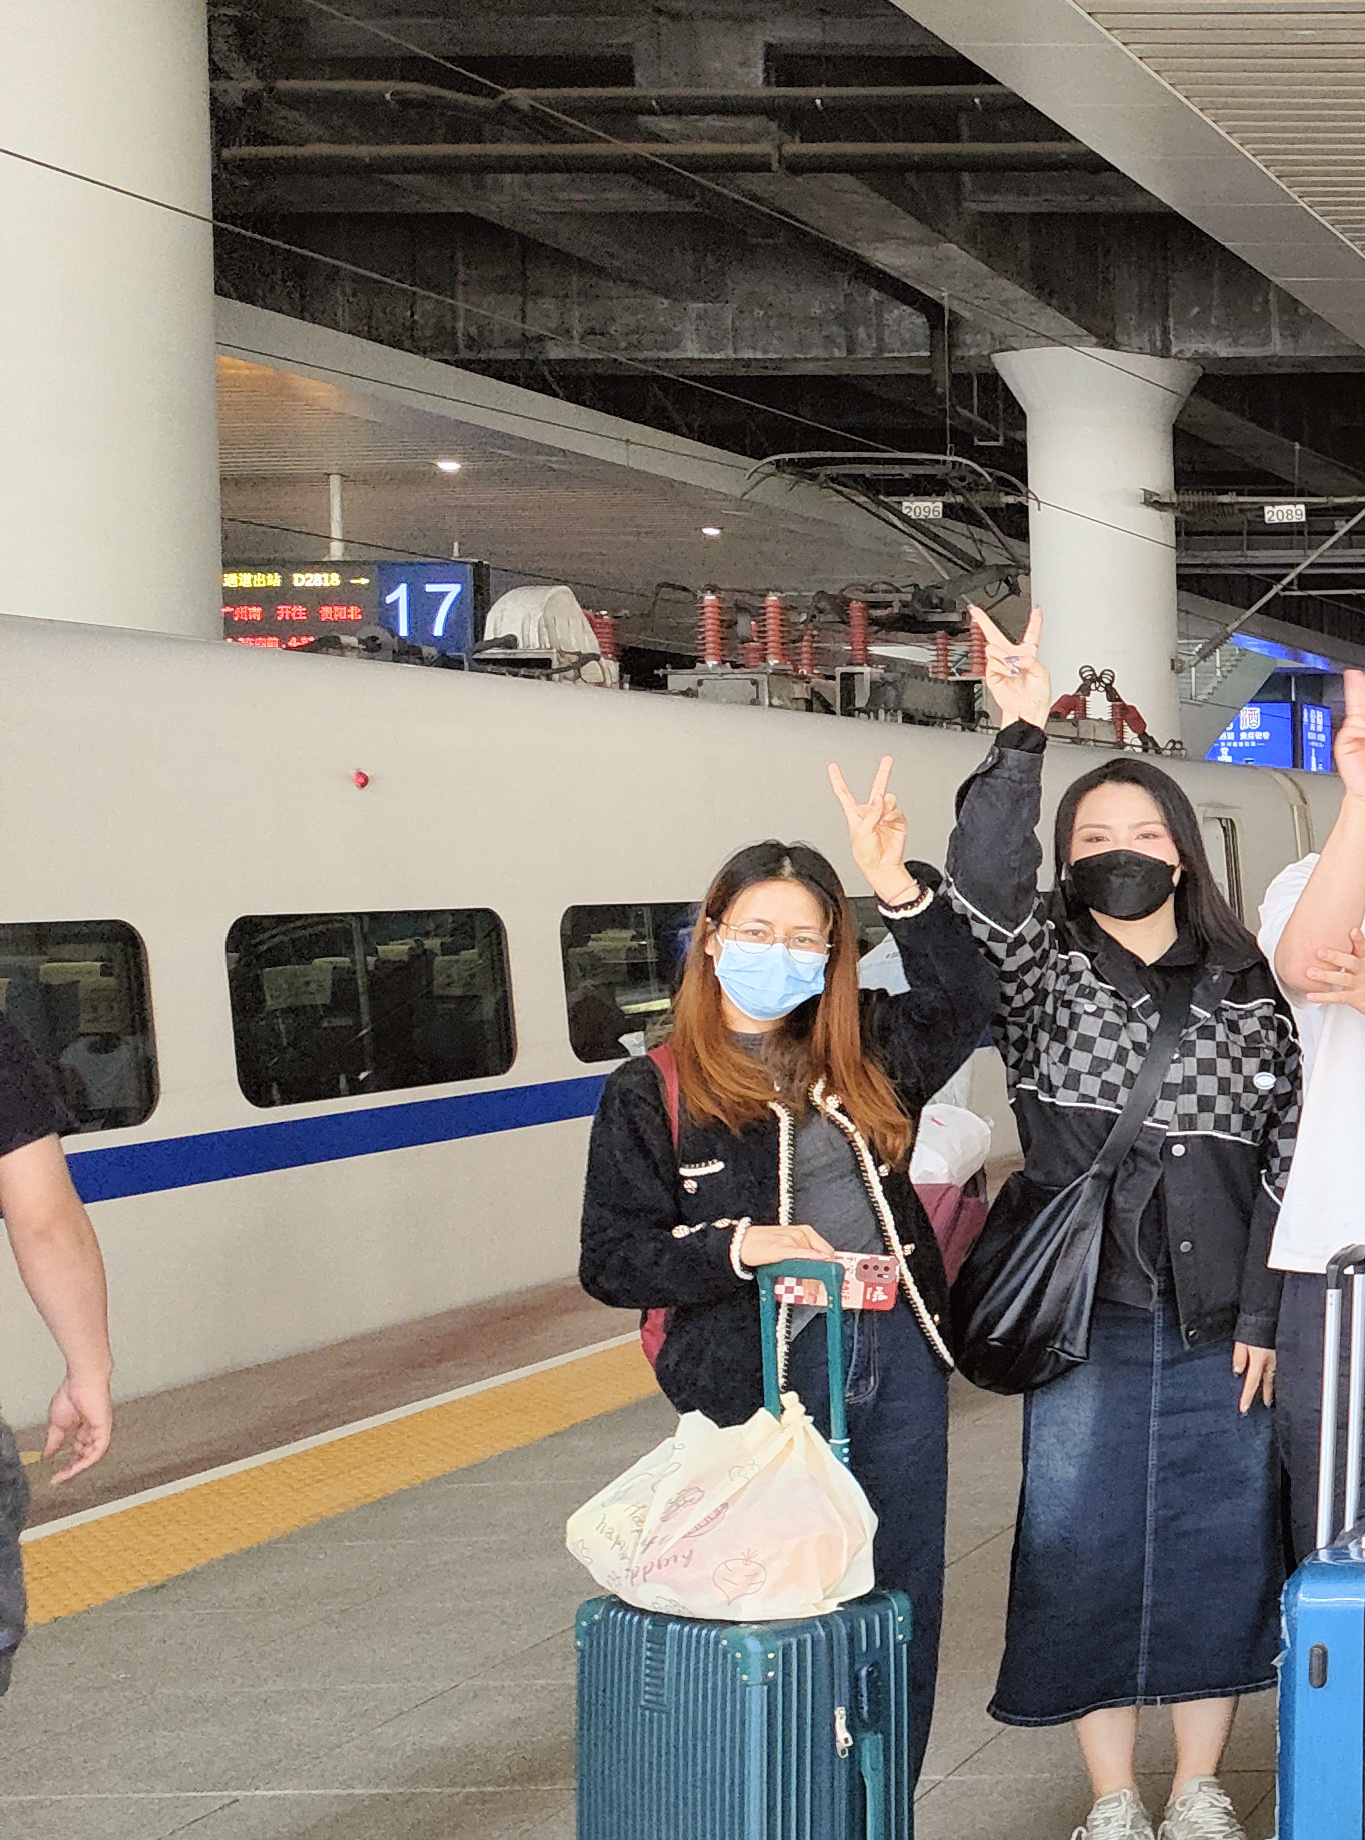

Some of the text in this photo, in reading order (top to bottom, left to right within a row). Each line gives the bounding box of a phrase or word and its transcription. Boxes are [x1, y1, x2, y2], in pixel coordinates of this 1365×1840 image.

[904, 505, 941, 518] 2096
[1267, 508, 1303, 521] 2089
[292, 572, 341, 588] D2818
[276, 604, 308, 621] 开往
[319, 604, 364, 621] 贵阳北
[385, 583, 461, 637] 17
